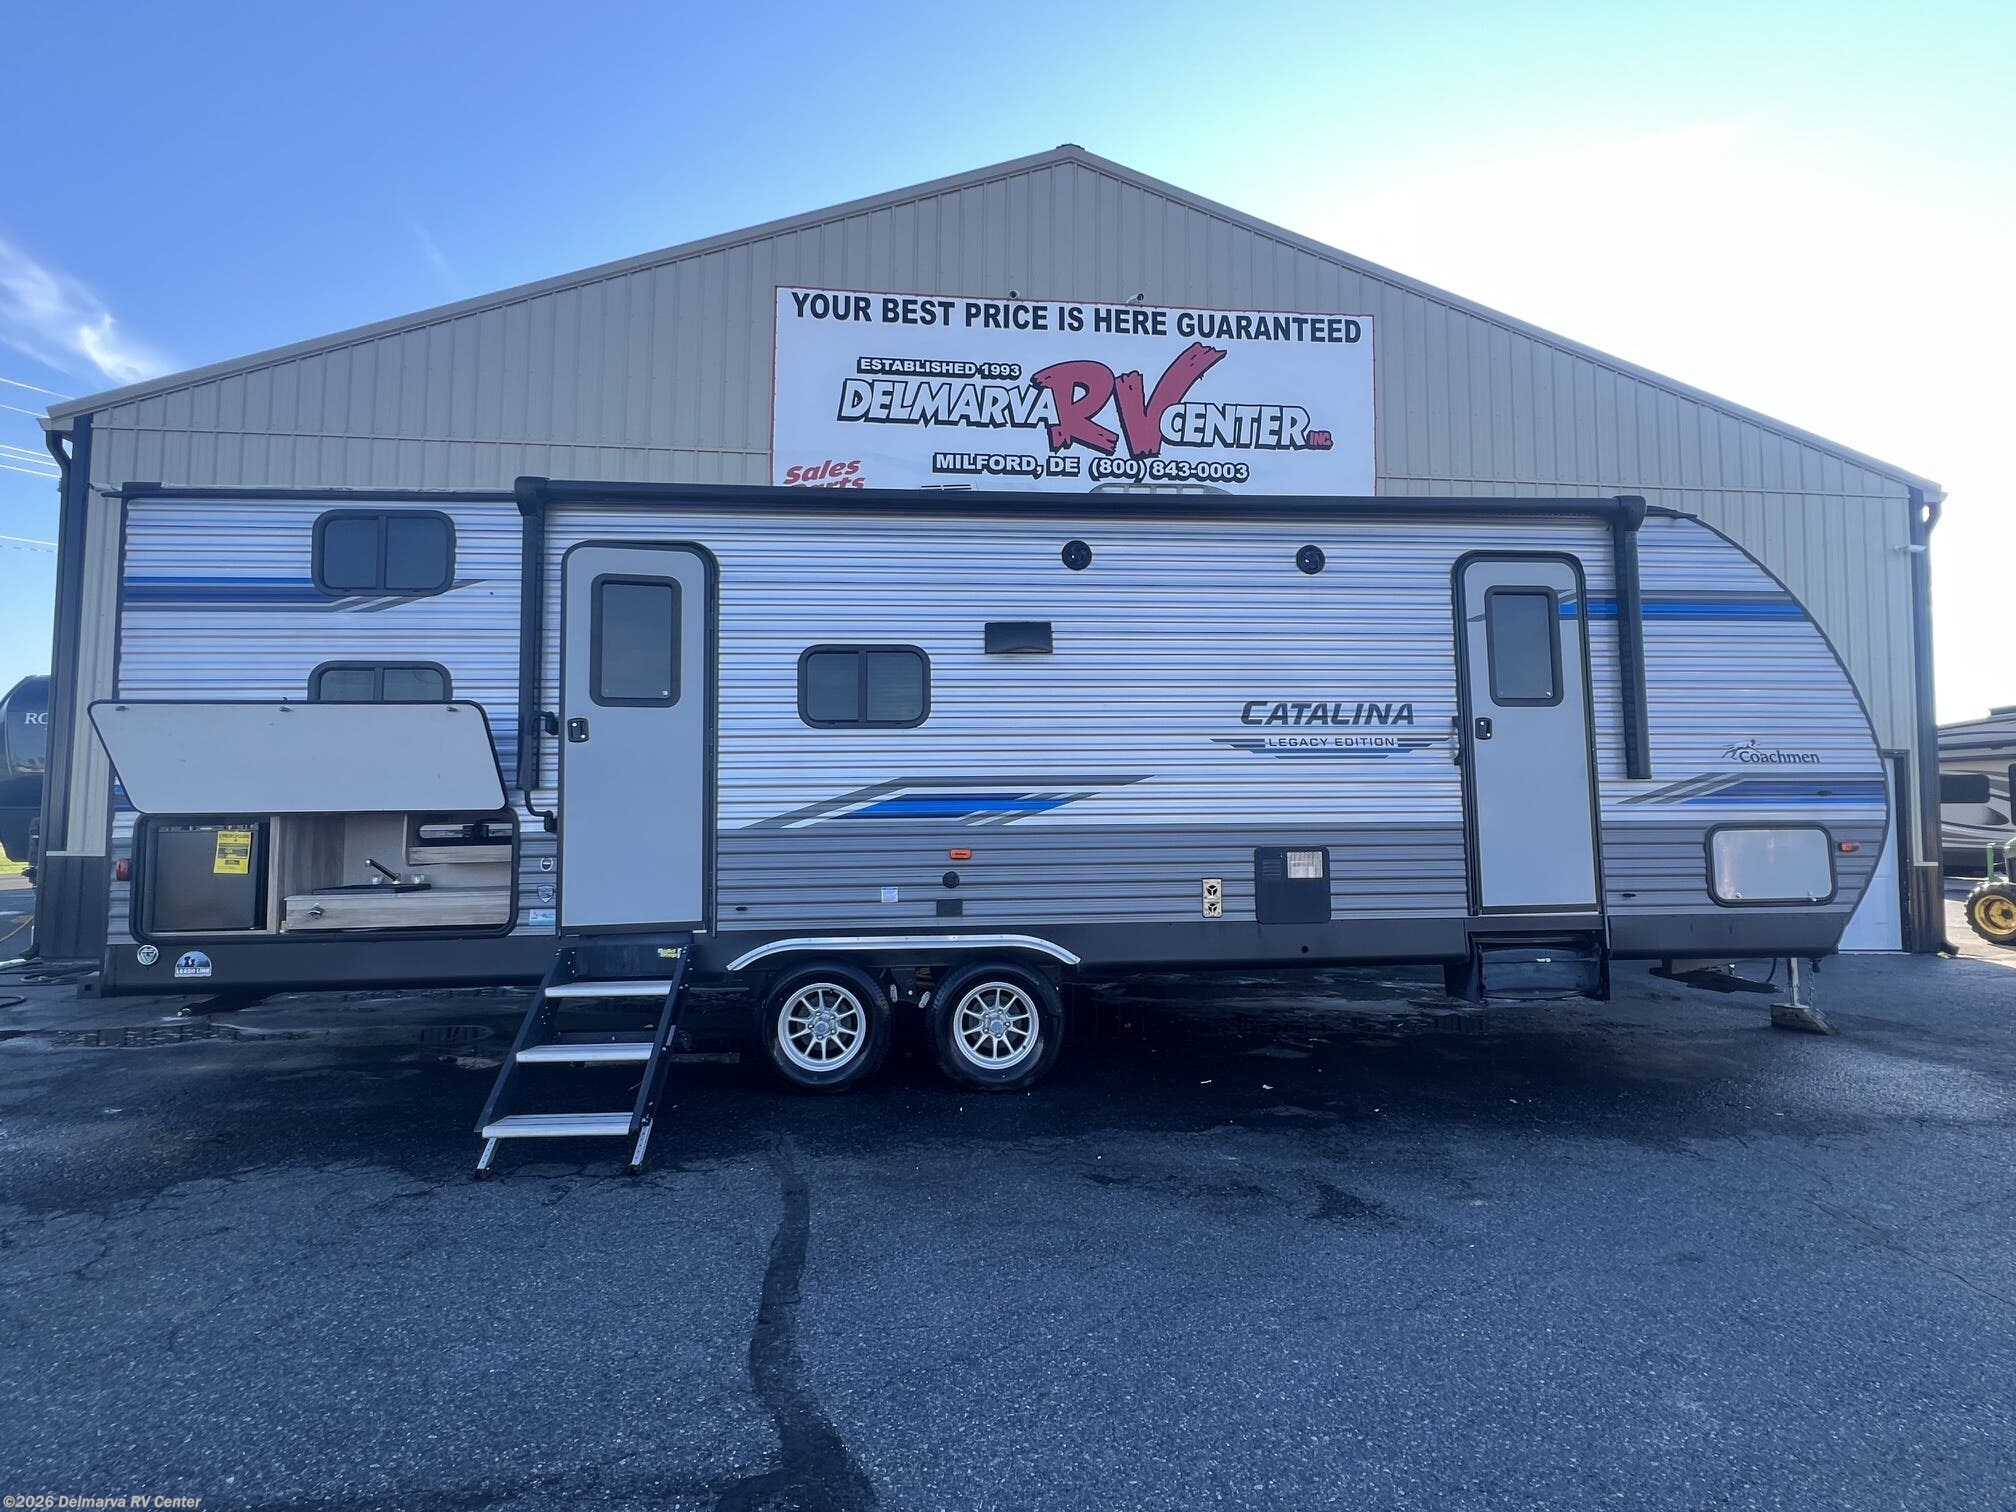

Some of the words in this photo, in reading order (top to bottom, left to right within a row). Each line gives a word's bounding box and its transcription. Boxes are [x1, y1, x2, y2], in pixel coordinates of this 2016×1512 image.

[791, 292, 872, 322] YOUR
[882, 298, 955, 326] BEST
[965, 302, 1048, 330] PRICE
[1058, 306, 1084, 332] IS
[1094, 308, 1167, 336] HERE
[1177, 313, 1361, 344] GUARANTEED
[858, 358, 976, 377] ESTABLISHED
[980, 363, 1021, 380] 1993
[838, 378, 1060, 428] DELMARVA
[1030, 342, 1227, 457] RV
[1159, 402, 1310, 449] CENTER
[783, 459, 862, 485] Sales
[934, 452, 1044, 478] MILFORD,
[1047, 456, 1080, 477] DE
[1089, 457, 1146, 480] (800)
[1151, 461, 1249, 482] 843-0003
[1240, 700, 1415, 726] CATALINA
[1268, 737, 1328, 748] LEGACY
[1334, 737, 1395, 748] EDITION
[1739, 750, 1820, 764] Coachmen
